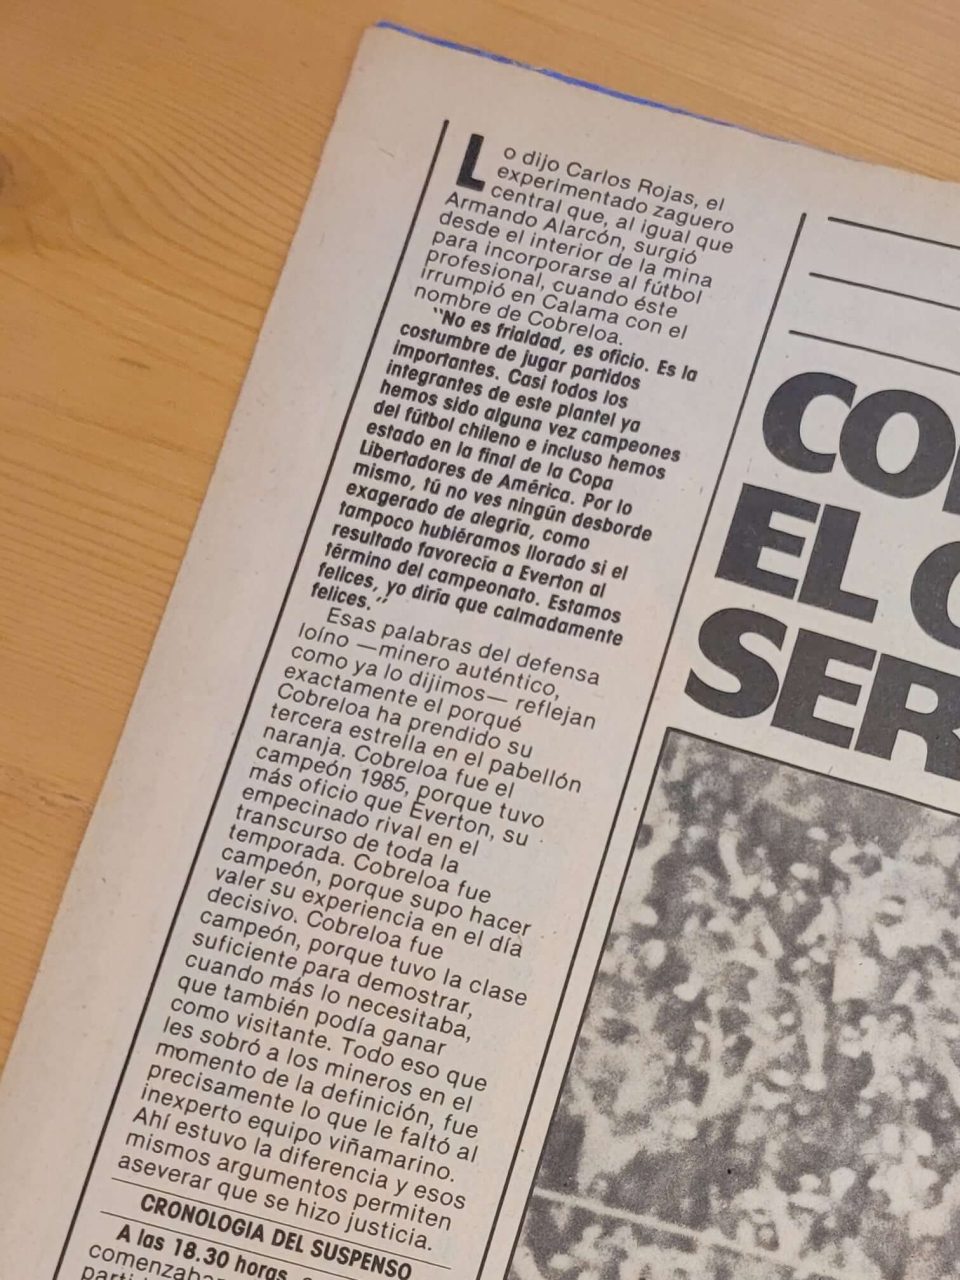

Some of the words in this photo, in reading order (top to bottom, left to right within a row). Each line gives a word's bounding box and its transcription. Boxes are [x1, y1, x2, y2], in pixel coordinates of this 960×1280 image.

[444, 191, 538, 228] Armando
[542, 216, 626, 253] Alarcón,
[633, 240, 698, 265] surgió
[359, 438, 467, 480] Libertadores
[470, 467, 494, 486] de
[496, 473, 575, 506] América.
[581, 492, 614, 512] Por
[615, 498, 633, 516] lo
[324, 541, 392, 571] término
[396, 559, 425, 579] del
[427, 567, 540, 607] campeonato.
[547, 593, 622, 624] Estamos
[714, 484, 879, 623] EL
[262, 725, 346, 758] naranja.
[354, 744, 448, 782] Cobreloa
[455, 767, 489, 792] fue
[494, 781, 516, 799] el
[192, 932, 298, 971] suficiente
[301, 960, 351, 984] para
[357, 971, 473, 1020] demostrar,
[115, 1223, 131, 1244] A
[136, 1227, 166, 1252] las
[173, 1237, 231, 1269] 18.30
[140, 1193, 265, 1243] CRONOLOGIA
[270, 1227, 304, 1254] DEL
